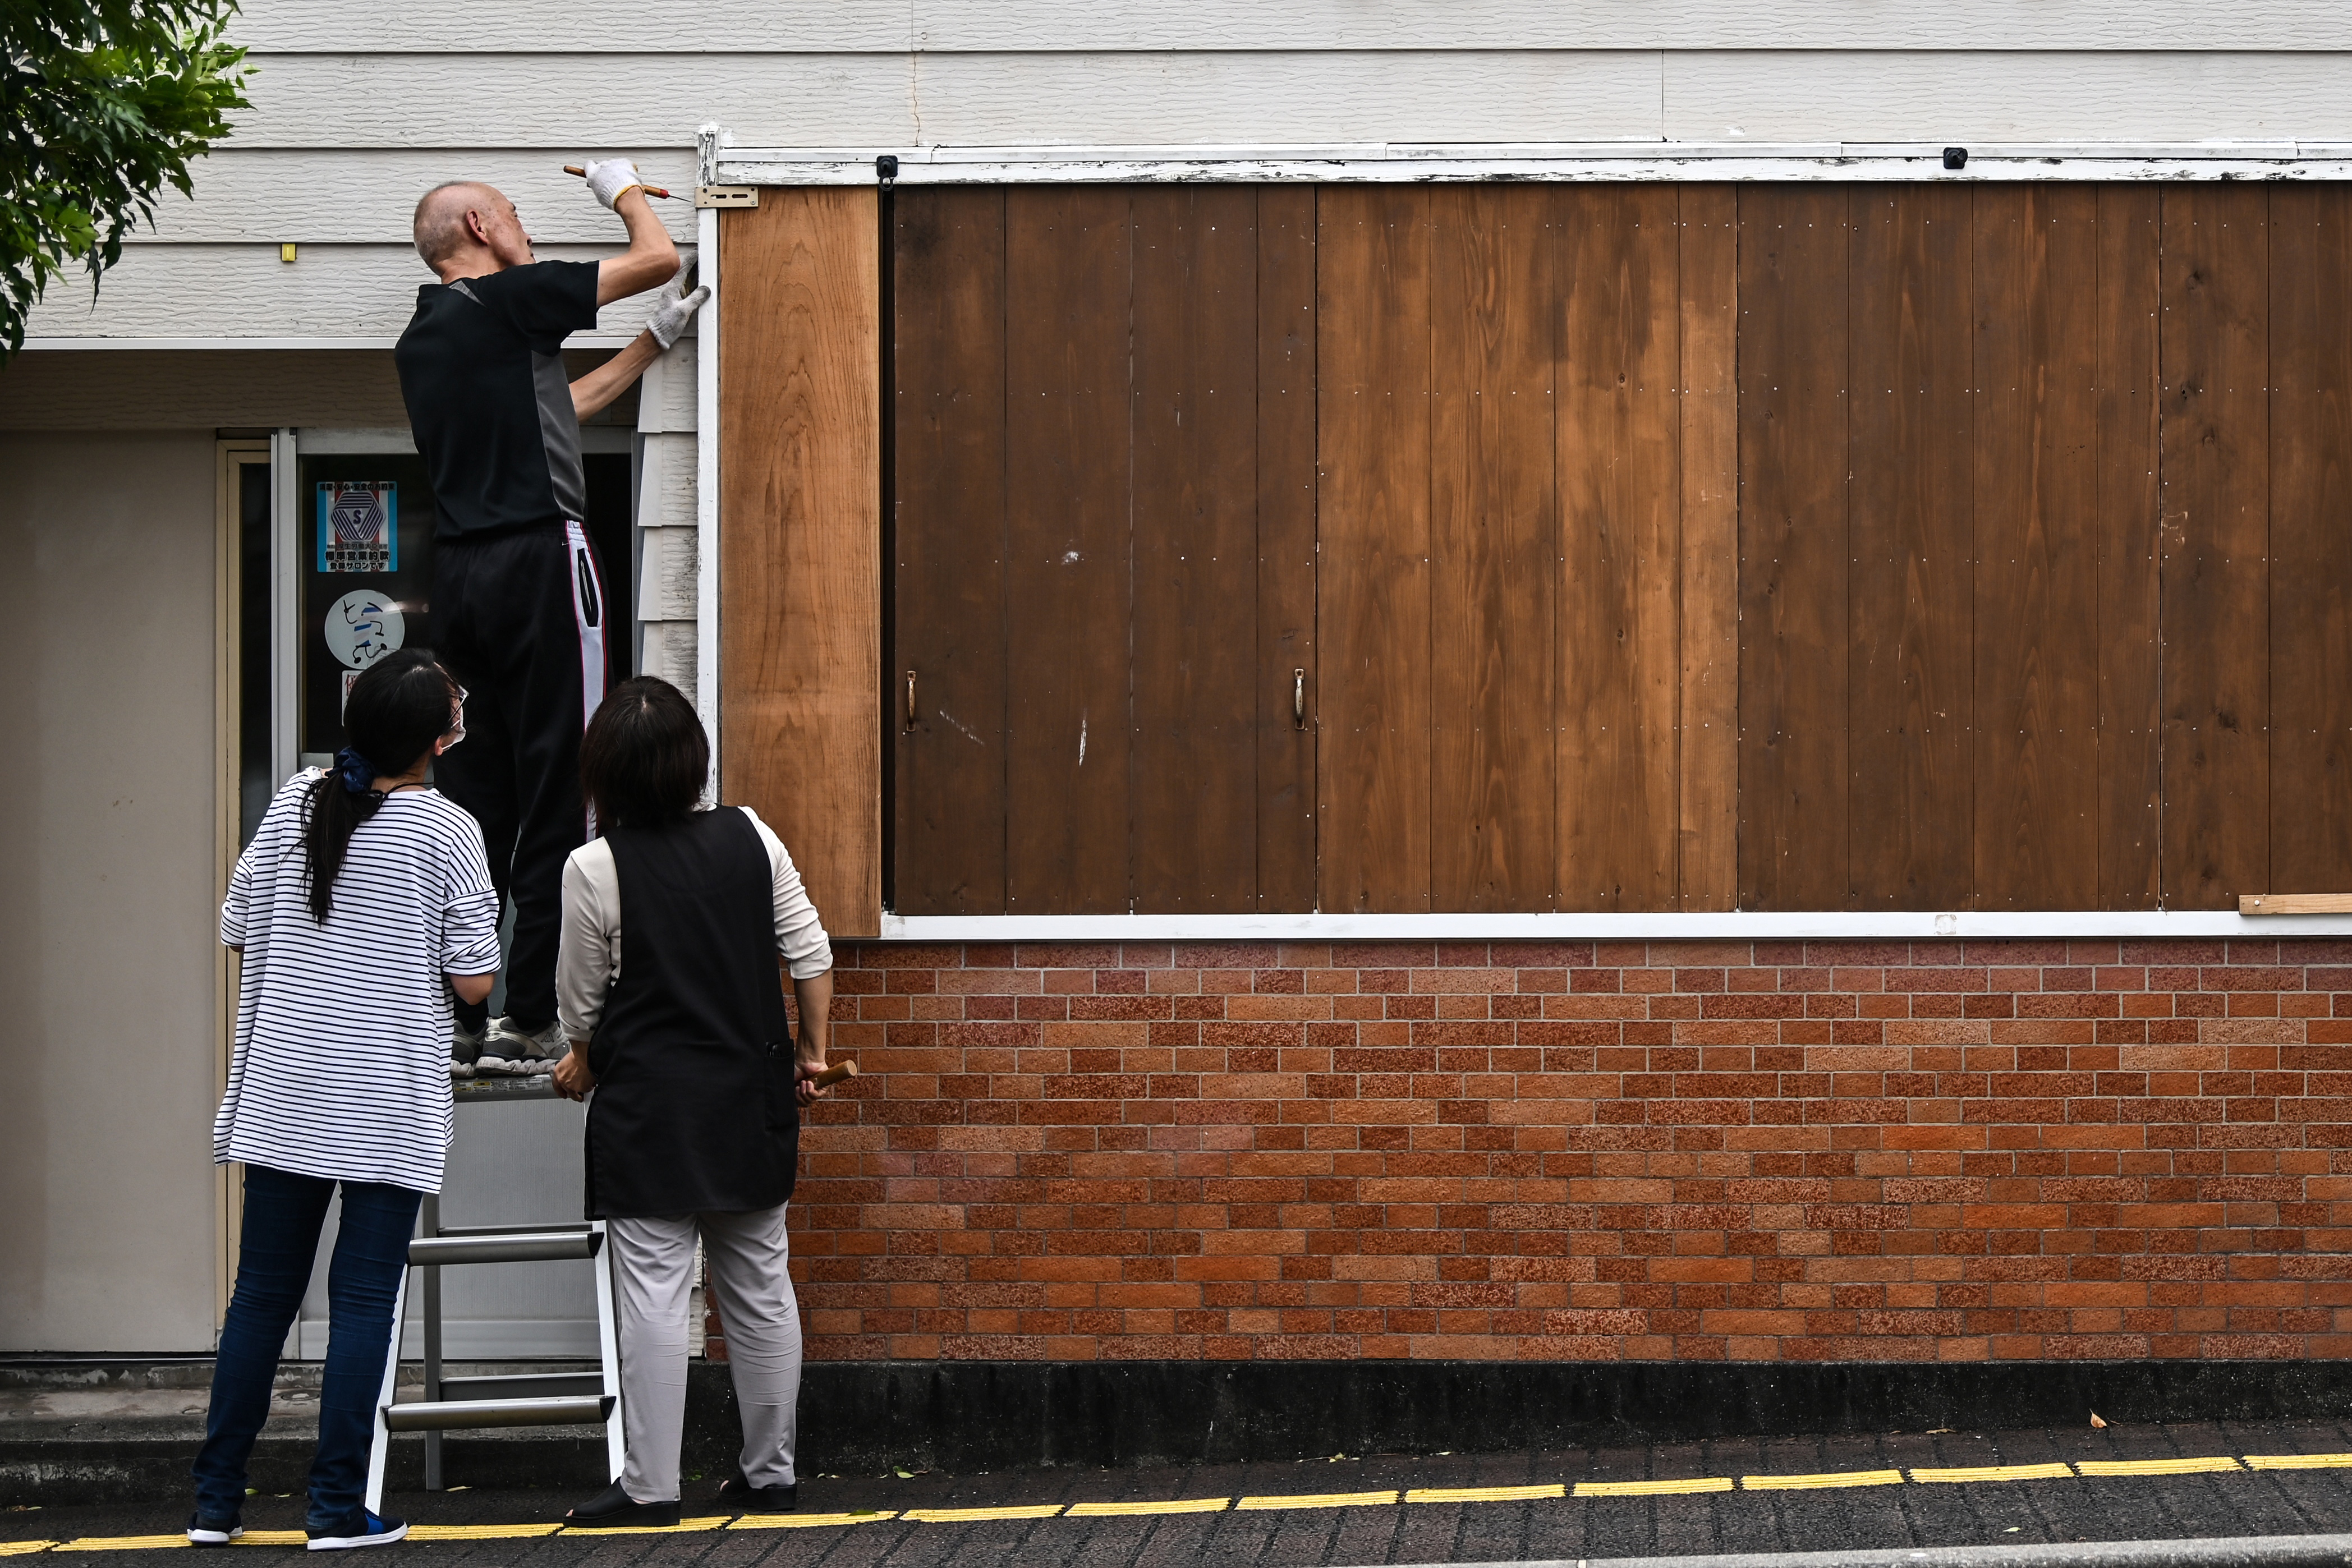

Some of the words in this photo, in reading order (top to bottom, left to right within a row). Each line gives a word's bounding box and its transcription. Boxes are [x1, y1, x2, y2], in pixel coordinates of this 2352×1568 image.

[353, 509, 361, 524] S
[325, 551, 389, 560] 標準営業約款
